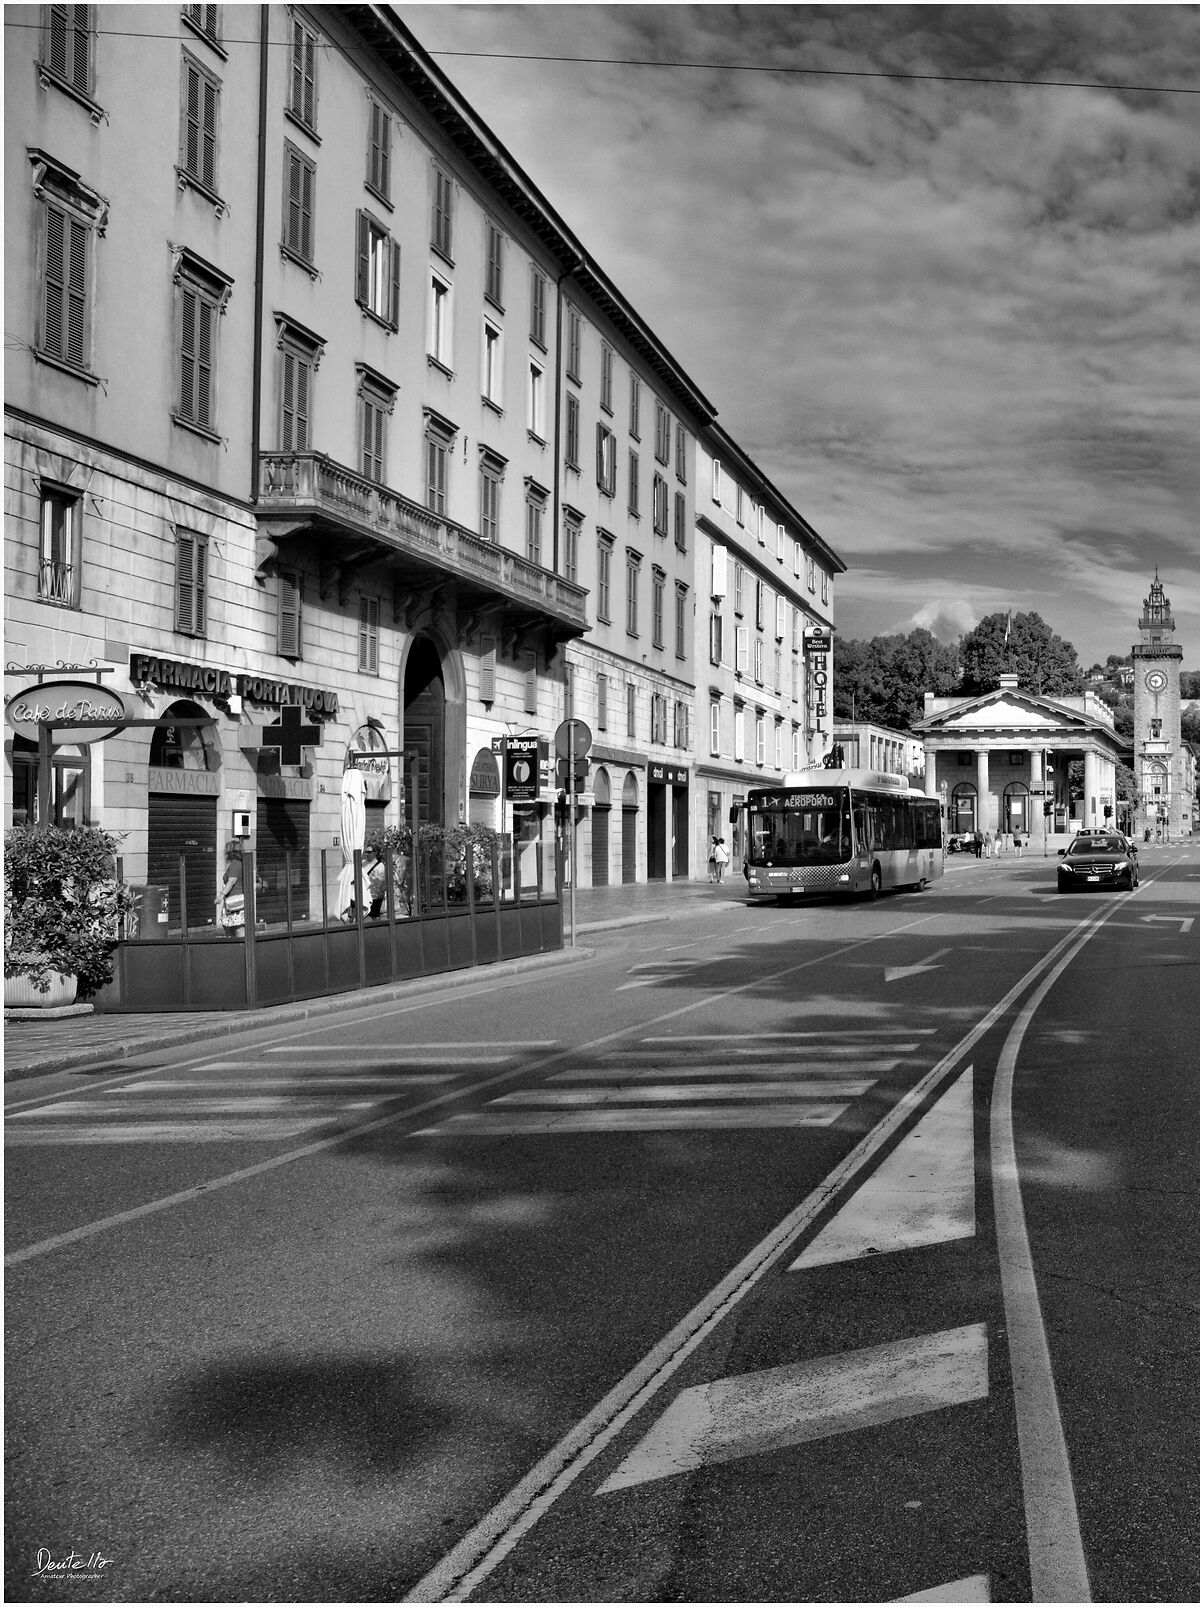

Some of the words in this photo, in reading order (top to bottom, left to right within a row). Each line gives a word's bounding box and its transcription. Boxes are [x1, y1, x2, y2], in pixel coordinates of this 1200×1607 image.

[135, 655, 232, 694] FARMACIA
[242, 675, 290, 705] PORTA
[294, 686, 340, 713] NUOVA
[814, 656, 827, 733] HOTEL
[56, 701, 76, 719] de
[77, 700, 123, 720] Paris
[507, 738, 538, 751] inlingua
[149, 770, 219, 793] FARMACIA
[761, 797, 769, 807] 1
[784, 796, 834, 807] AEROPORTO
